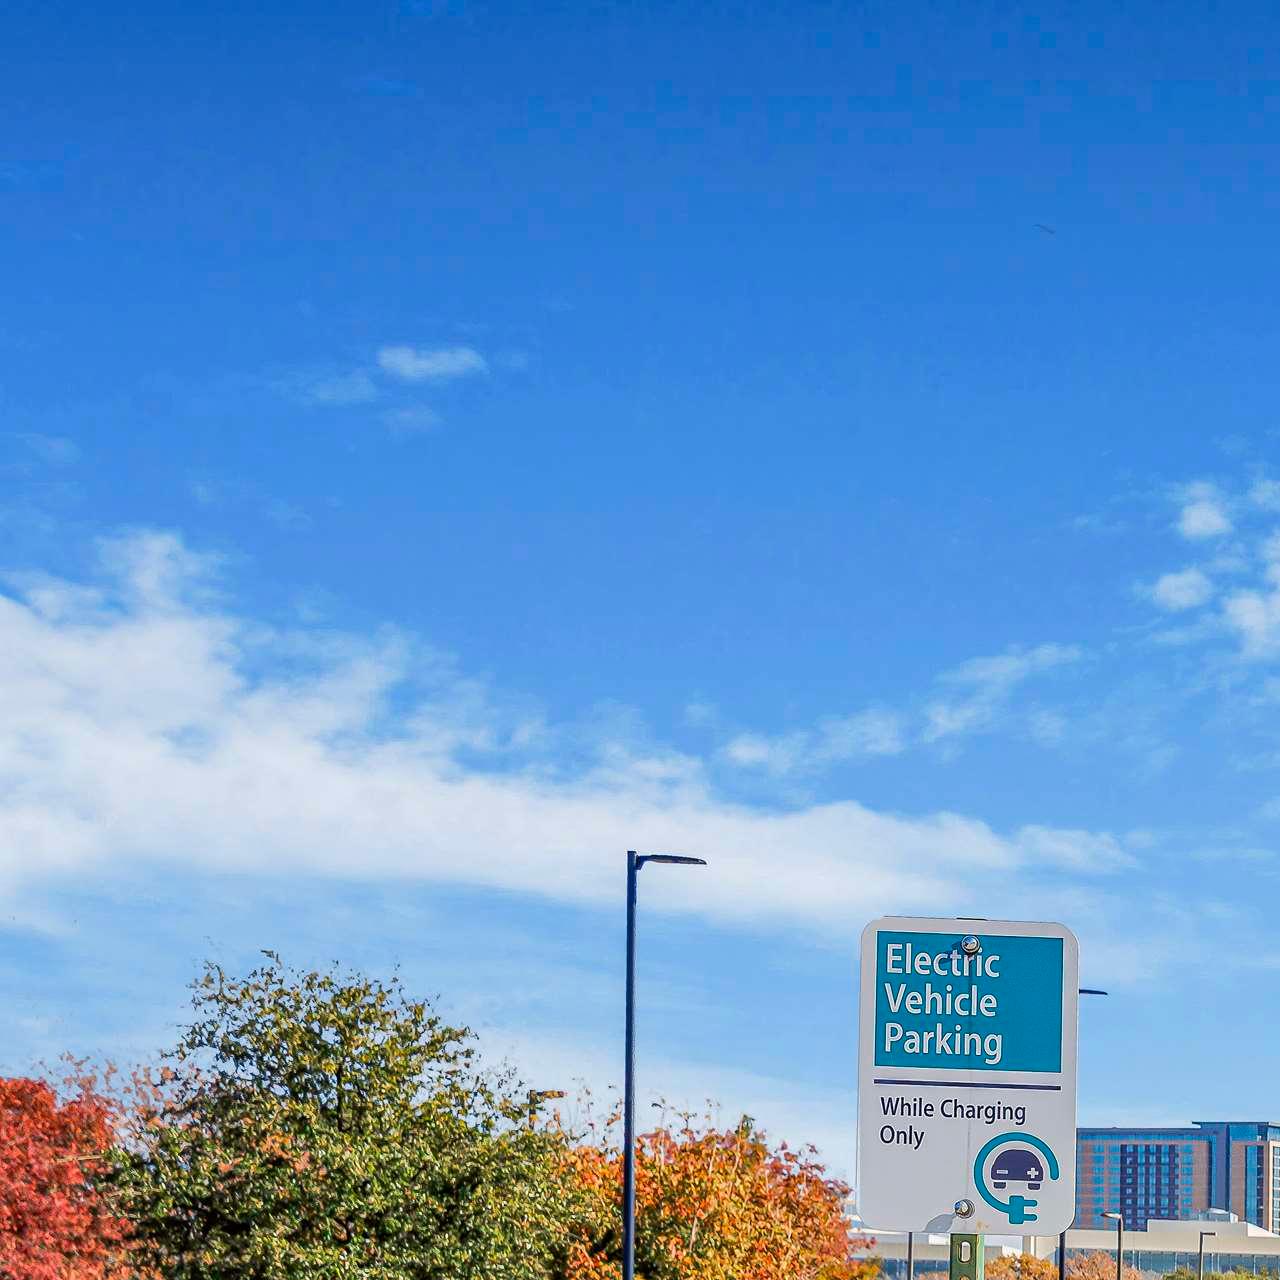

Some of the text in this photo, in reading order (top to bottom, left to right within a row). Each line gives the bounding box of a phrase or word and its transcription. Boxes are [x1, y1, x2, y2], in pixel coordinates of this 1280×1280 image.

[886, 943, 1001, 978] Electric
[884, 983, 998, 1017] Vehicle
[884, 1023, 1003, 1065] Parking
[880, 1096, 1026, 1125] While Charging
[880, 1125, 925, 1150] Only
